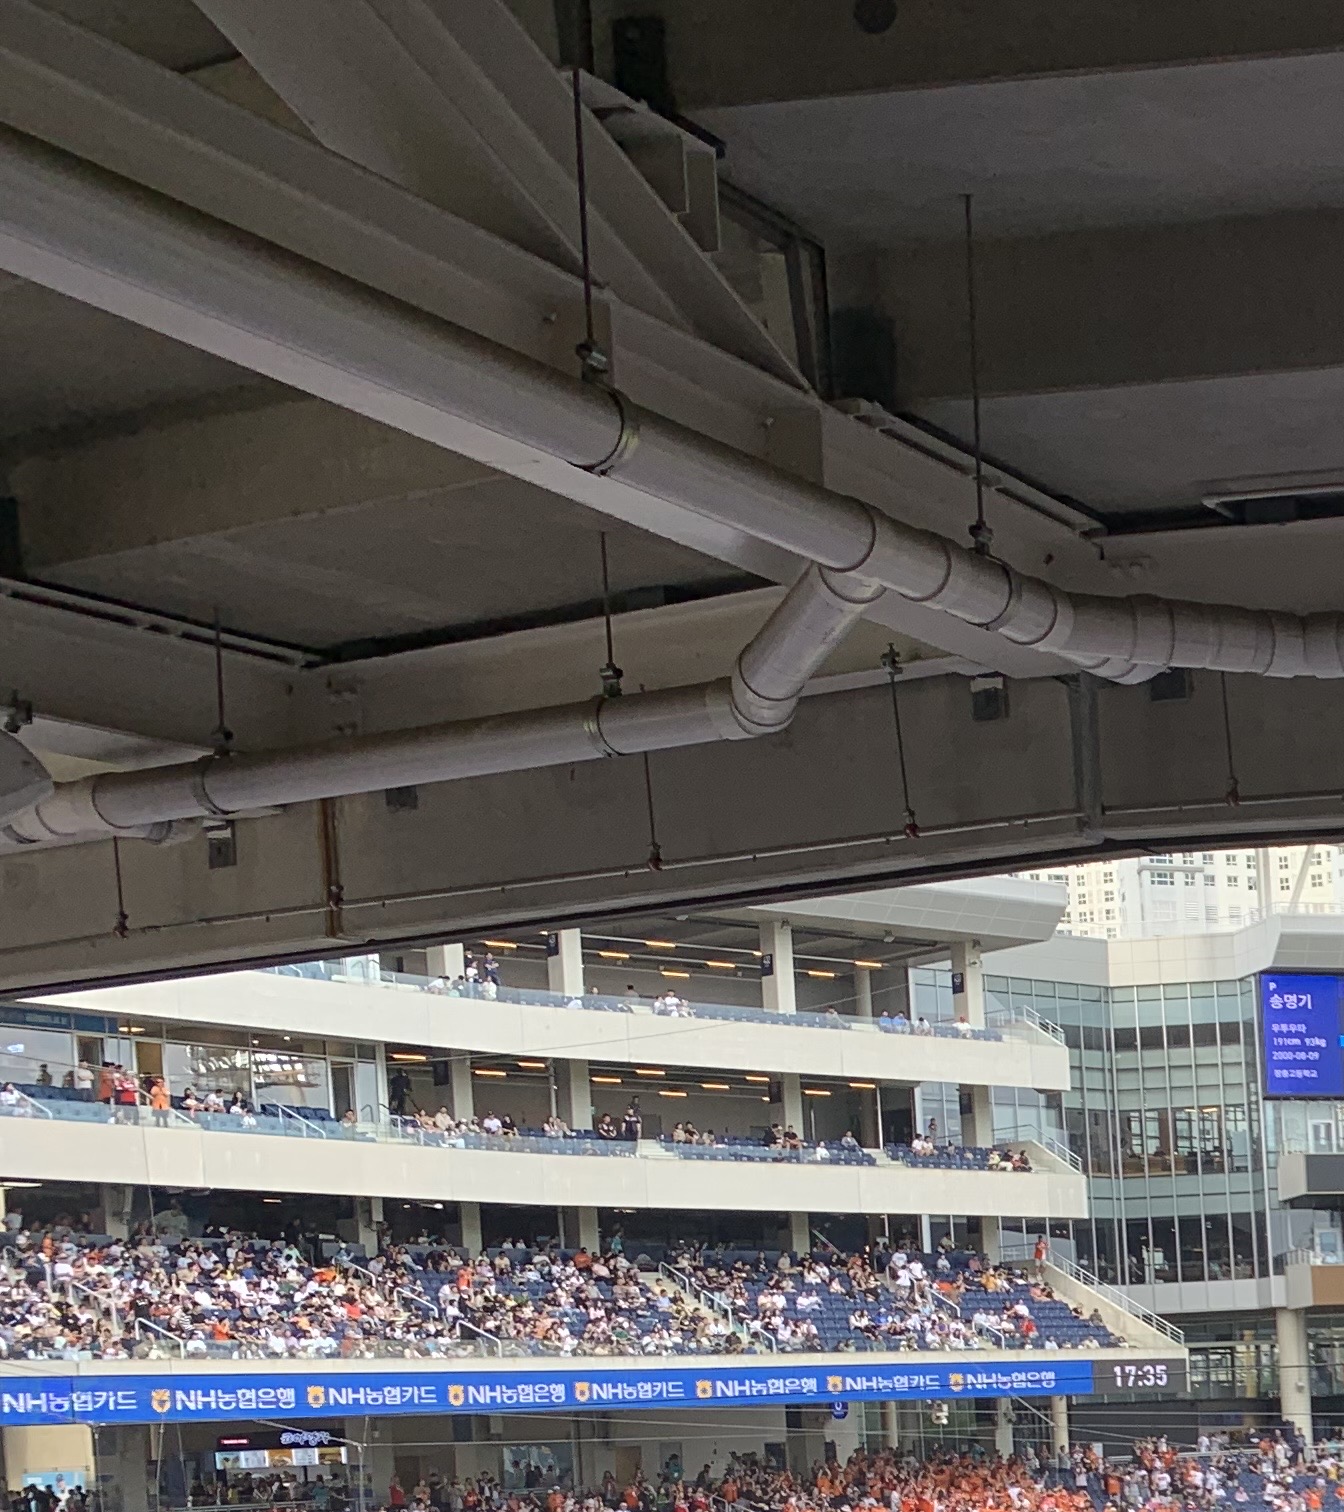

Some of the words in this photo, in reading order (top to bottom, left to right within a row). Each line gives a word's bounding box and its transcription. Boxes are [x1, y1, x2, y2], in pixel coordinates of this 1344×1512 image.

[1269, 994, 1312, 1010] 송명기
[845, 1374, 940, 1392] NH농협카드
[967, 1371, 1056, 1390] NH농협은행
[1112, 1365, 1168, 1387] 17:35
[328, 1385, 437, 1406] NH농협카드
[468, 1383, 566, 1404] NH농협은행
[592, 1381, 685, 1400] NH농협카드
[716, 1378, 818, 1397] NH농협은행
[2, 1391, 137, 1413] NH농협카드
[175, 1387, 296, 1410] NH농협은행
